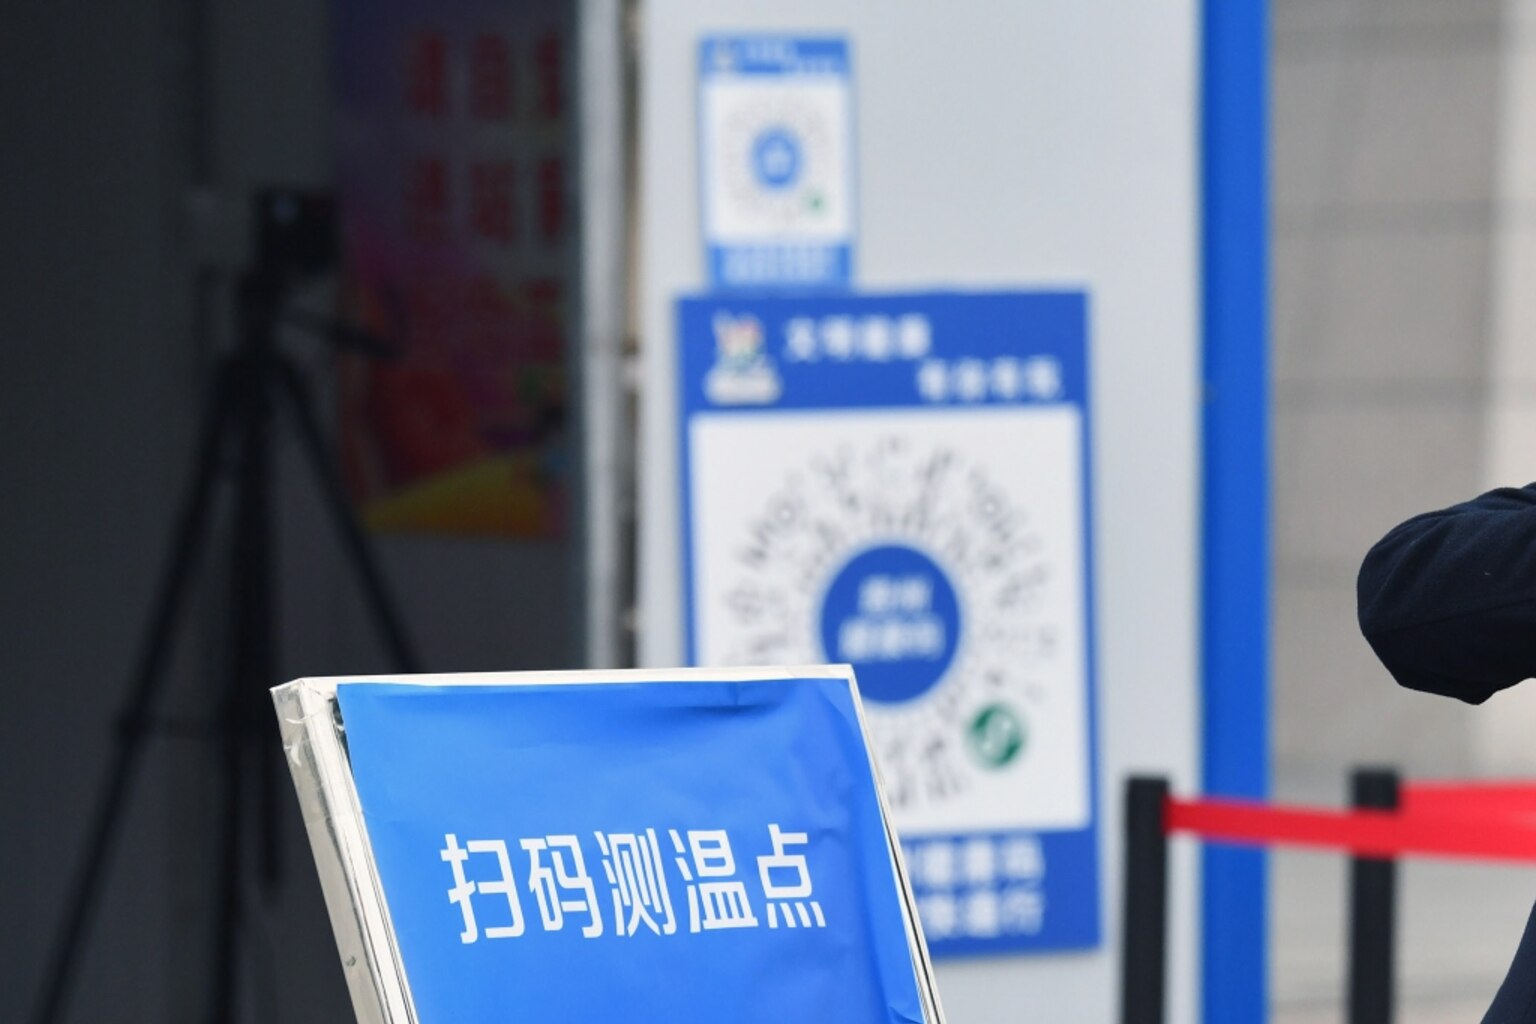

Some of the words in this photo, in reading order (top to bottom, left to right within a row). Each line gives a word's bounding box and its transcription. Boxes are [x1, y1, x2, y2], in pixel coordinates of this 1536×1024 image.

[440, 823, 827, 944] 扫码测温点
